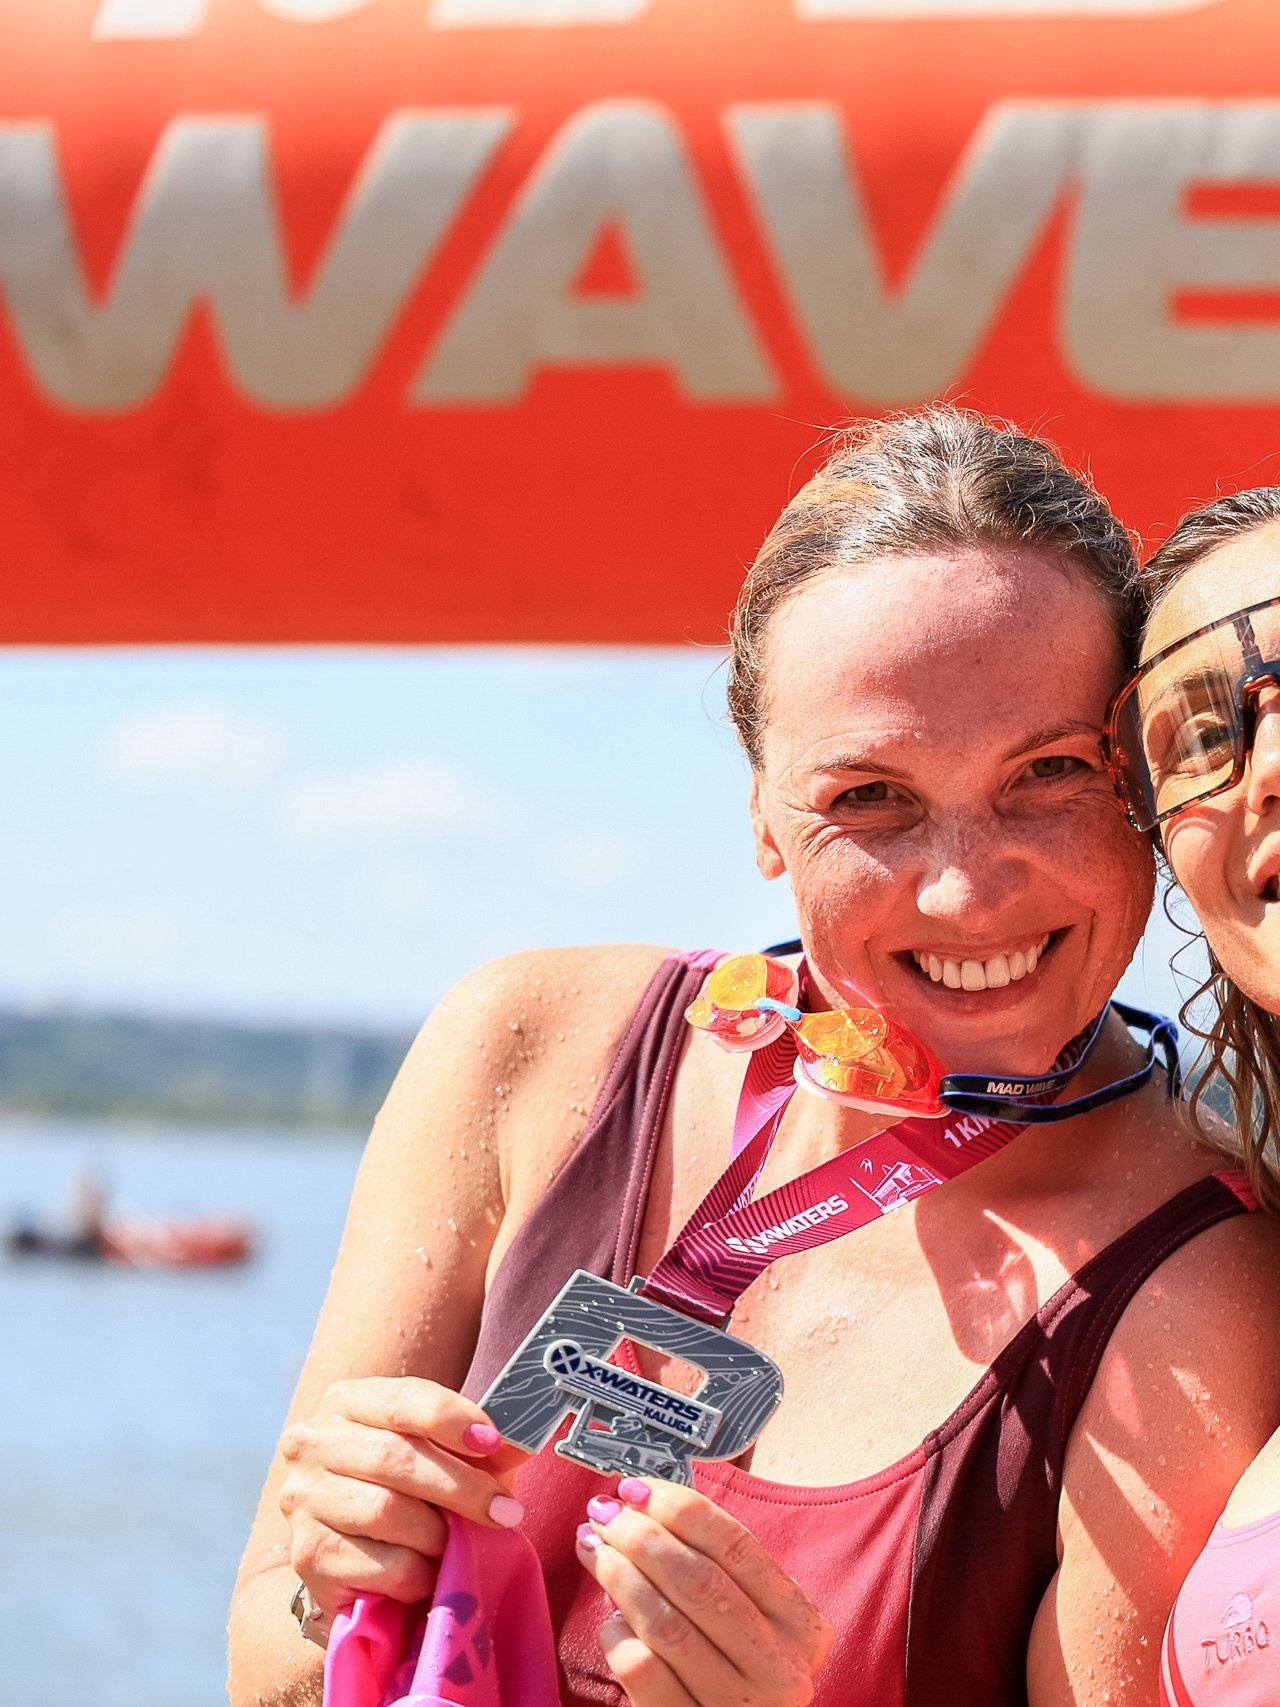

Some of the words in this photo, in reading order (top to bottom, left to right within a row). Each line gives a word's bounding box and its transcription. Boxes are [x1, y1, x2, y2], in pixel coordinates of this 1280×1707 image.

[986, 1081, 1025, 1095] MAD
[1025, 1079, 1056, 1095] WAVE
[943, 1128, 962, 1148] 1
[643, 1406, 694, 1436] KALUGA
[1201, 1620, 1271, 1666] TURBO
